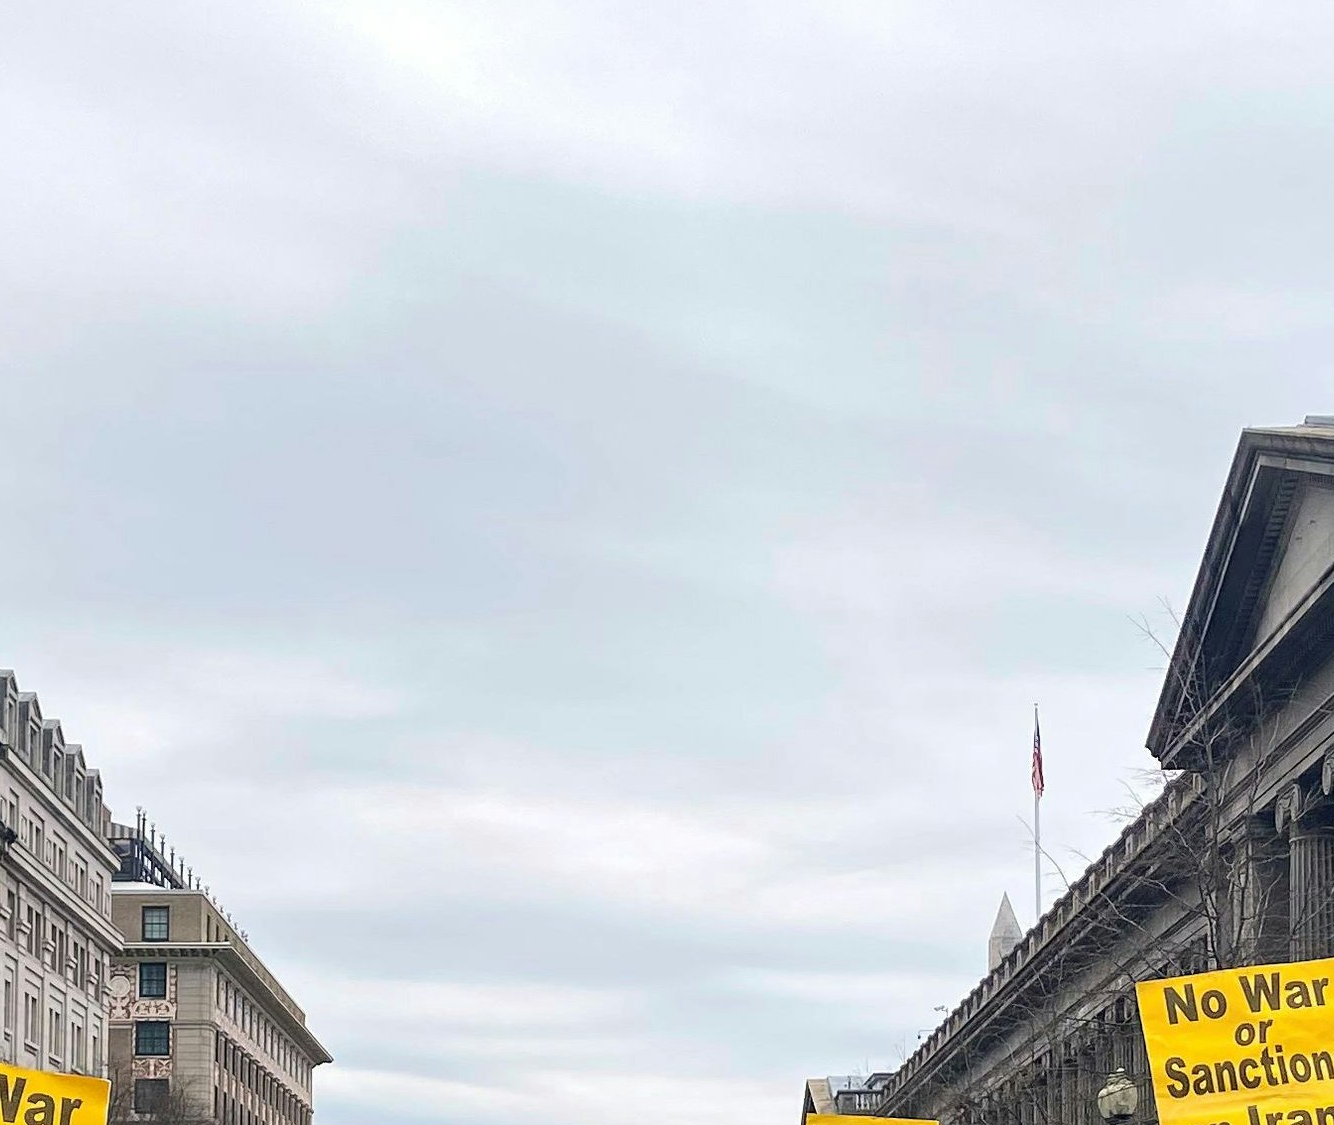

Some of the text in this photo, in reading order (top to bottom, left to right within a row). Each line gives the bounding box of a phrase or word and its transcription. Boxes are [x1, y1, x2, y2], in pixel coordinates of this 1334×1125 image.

[1164, 972, 1329, 1026] No War
[1235, 1019, 1274, 1046] or
